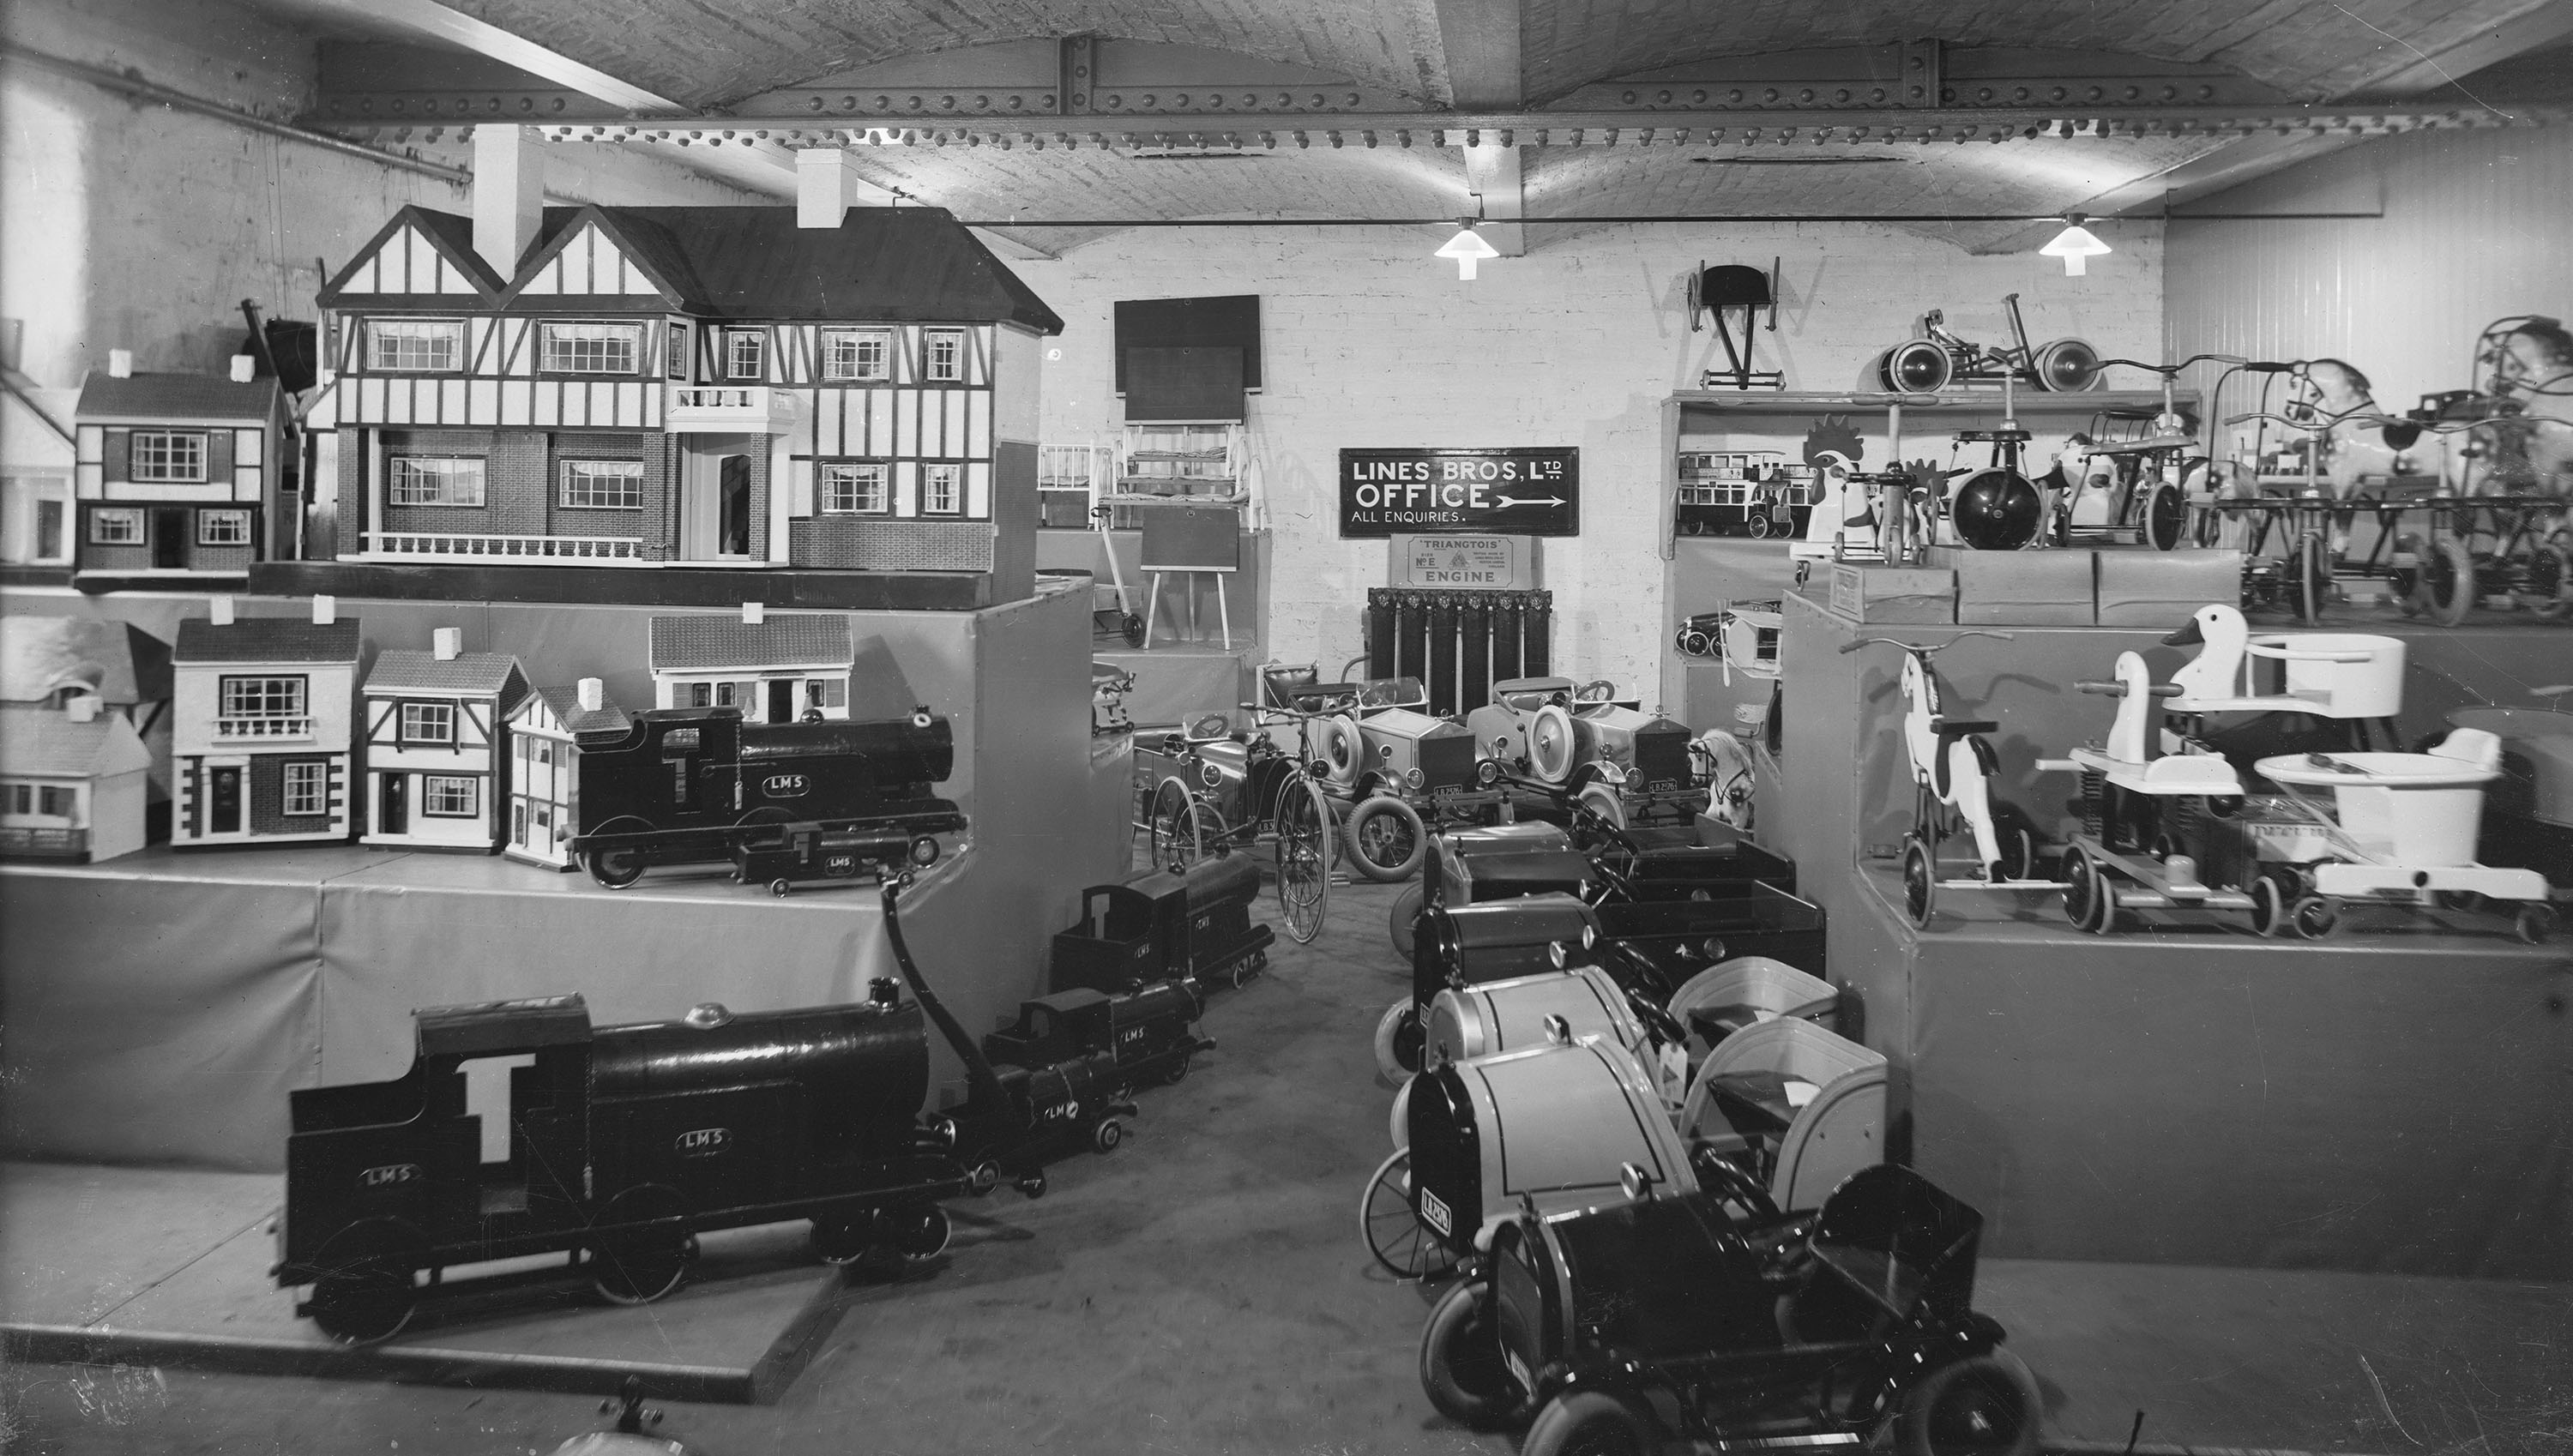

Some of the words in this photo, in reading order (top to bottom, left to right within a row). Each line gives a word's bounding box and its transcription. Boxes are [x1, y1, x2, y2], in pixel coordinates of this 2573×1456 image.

[1353, 461, 1430, 480] LINES
[1355, 484, 1490, 508] OFFICE
[1352, 511, 1378, 523] ALL
[1384, 511, 1467, 524] ENQUIRIES.
[1428, 557, 1436, 566] E
[1425, 571, 1495, 582] ENGINE
[771, 776, 803, 789] LMS
[830, 857, 851, 867] LMS
[1137, 943, 1150, 959] LMS
[1124, 1027, 1144, 1043] LMS
[685, 1130, 723, 1148] LMS
[367, 1165, 411, 1186] LMS
